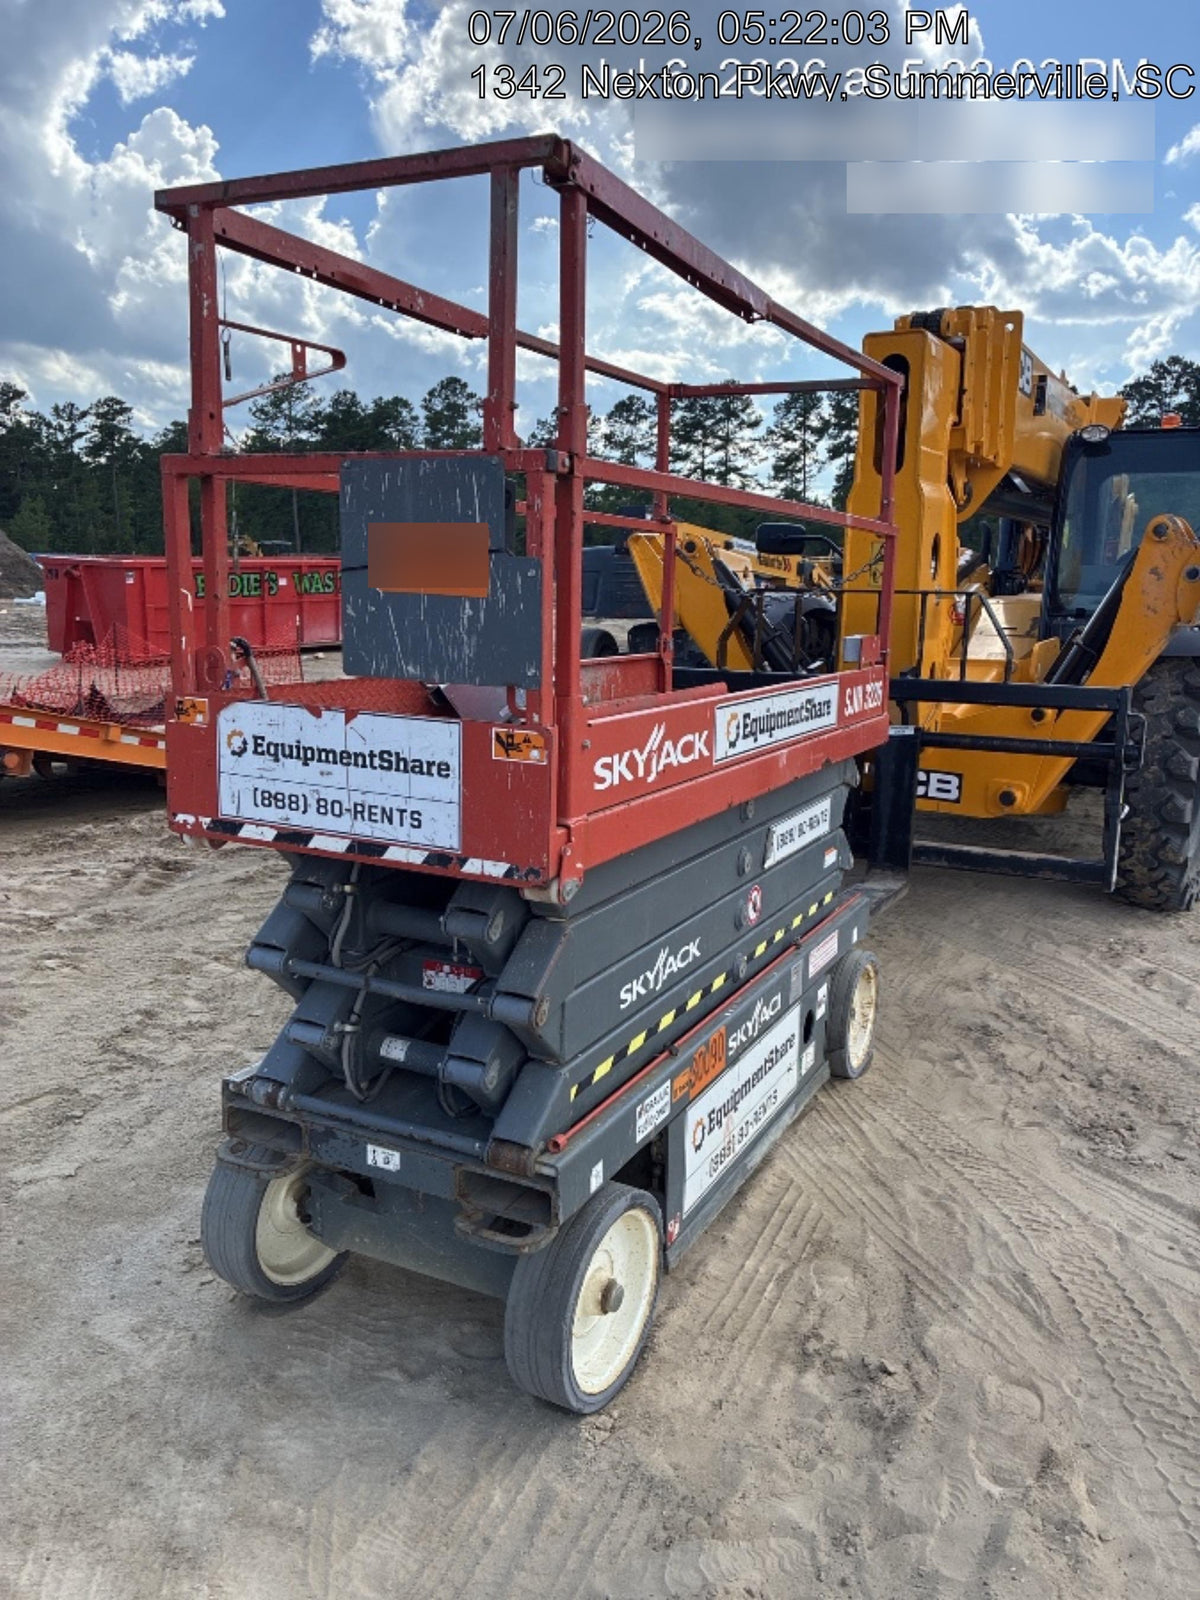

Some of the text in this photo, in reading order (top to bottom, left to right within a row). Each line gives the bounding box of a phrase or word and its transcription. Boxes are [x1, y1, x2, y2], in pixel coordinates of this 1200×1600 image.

[741, 697, 832, 744] EquipmentShare
[252, 734, 451, 779] EquipmentShare
[593, 722, 710, 790] SKYJACK
[253, 787, 423, 829] (888) 80-RENTS
[619, 936, 702, 1010] SKYJACK
[707, 1033, 796, 1136] EquipmentShare
